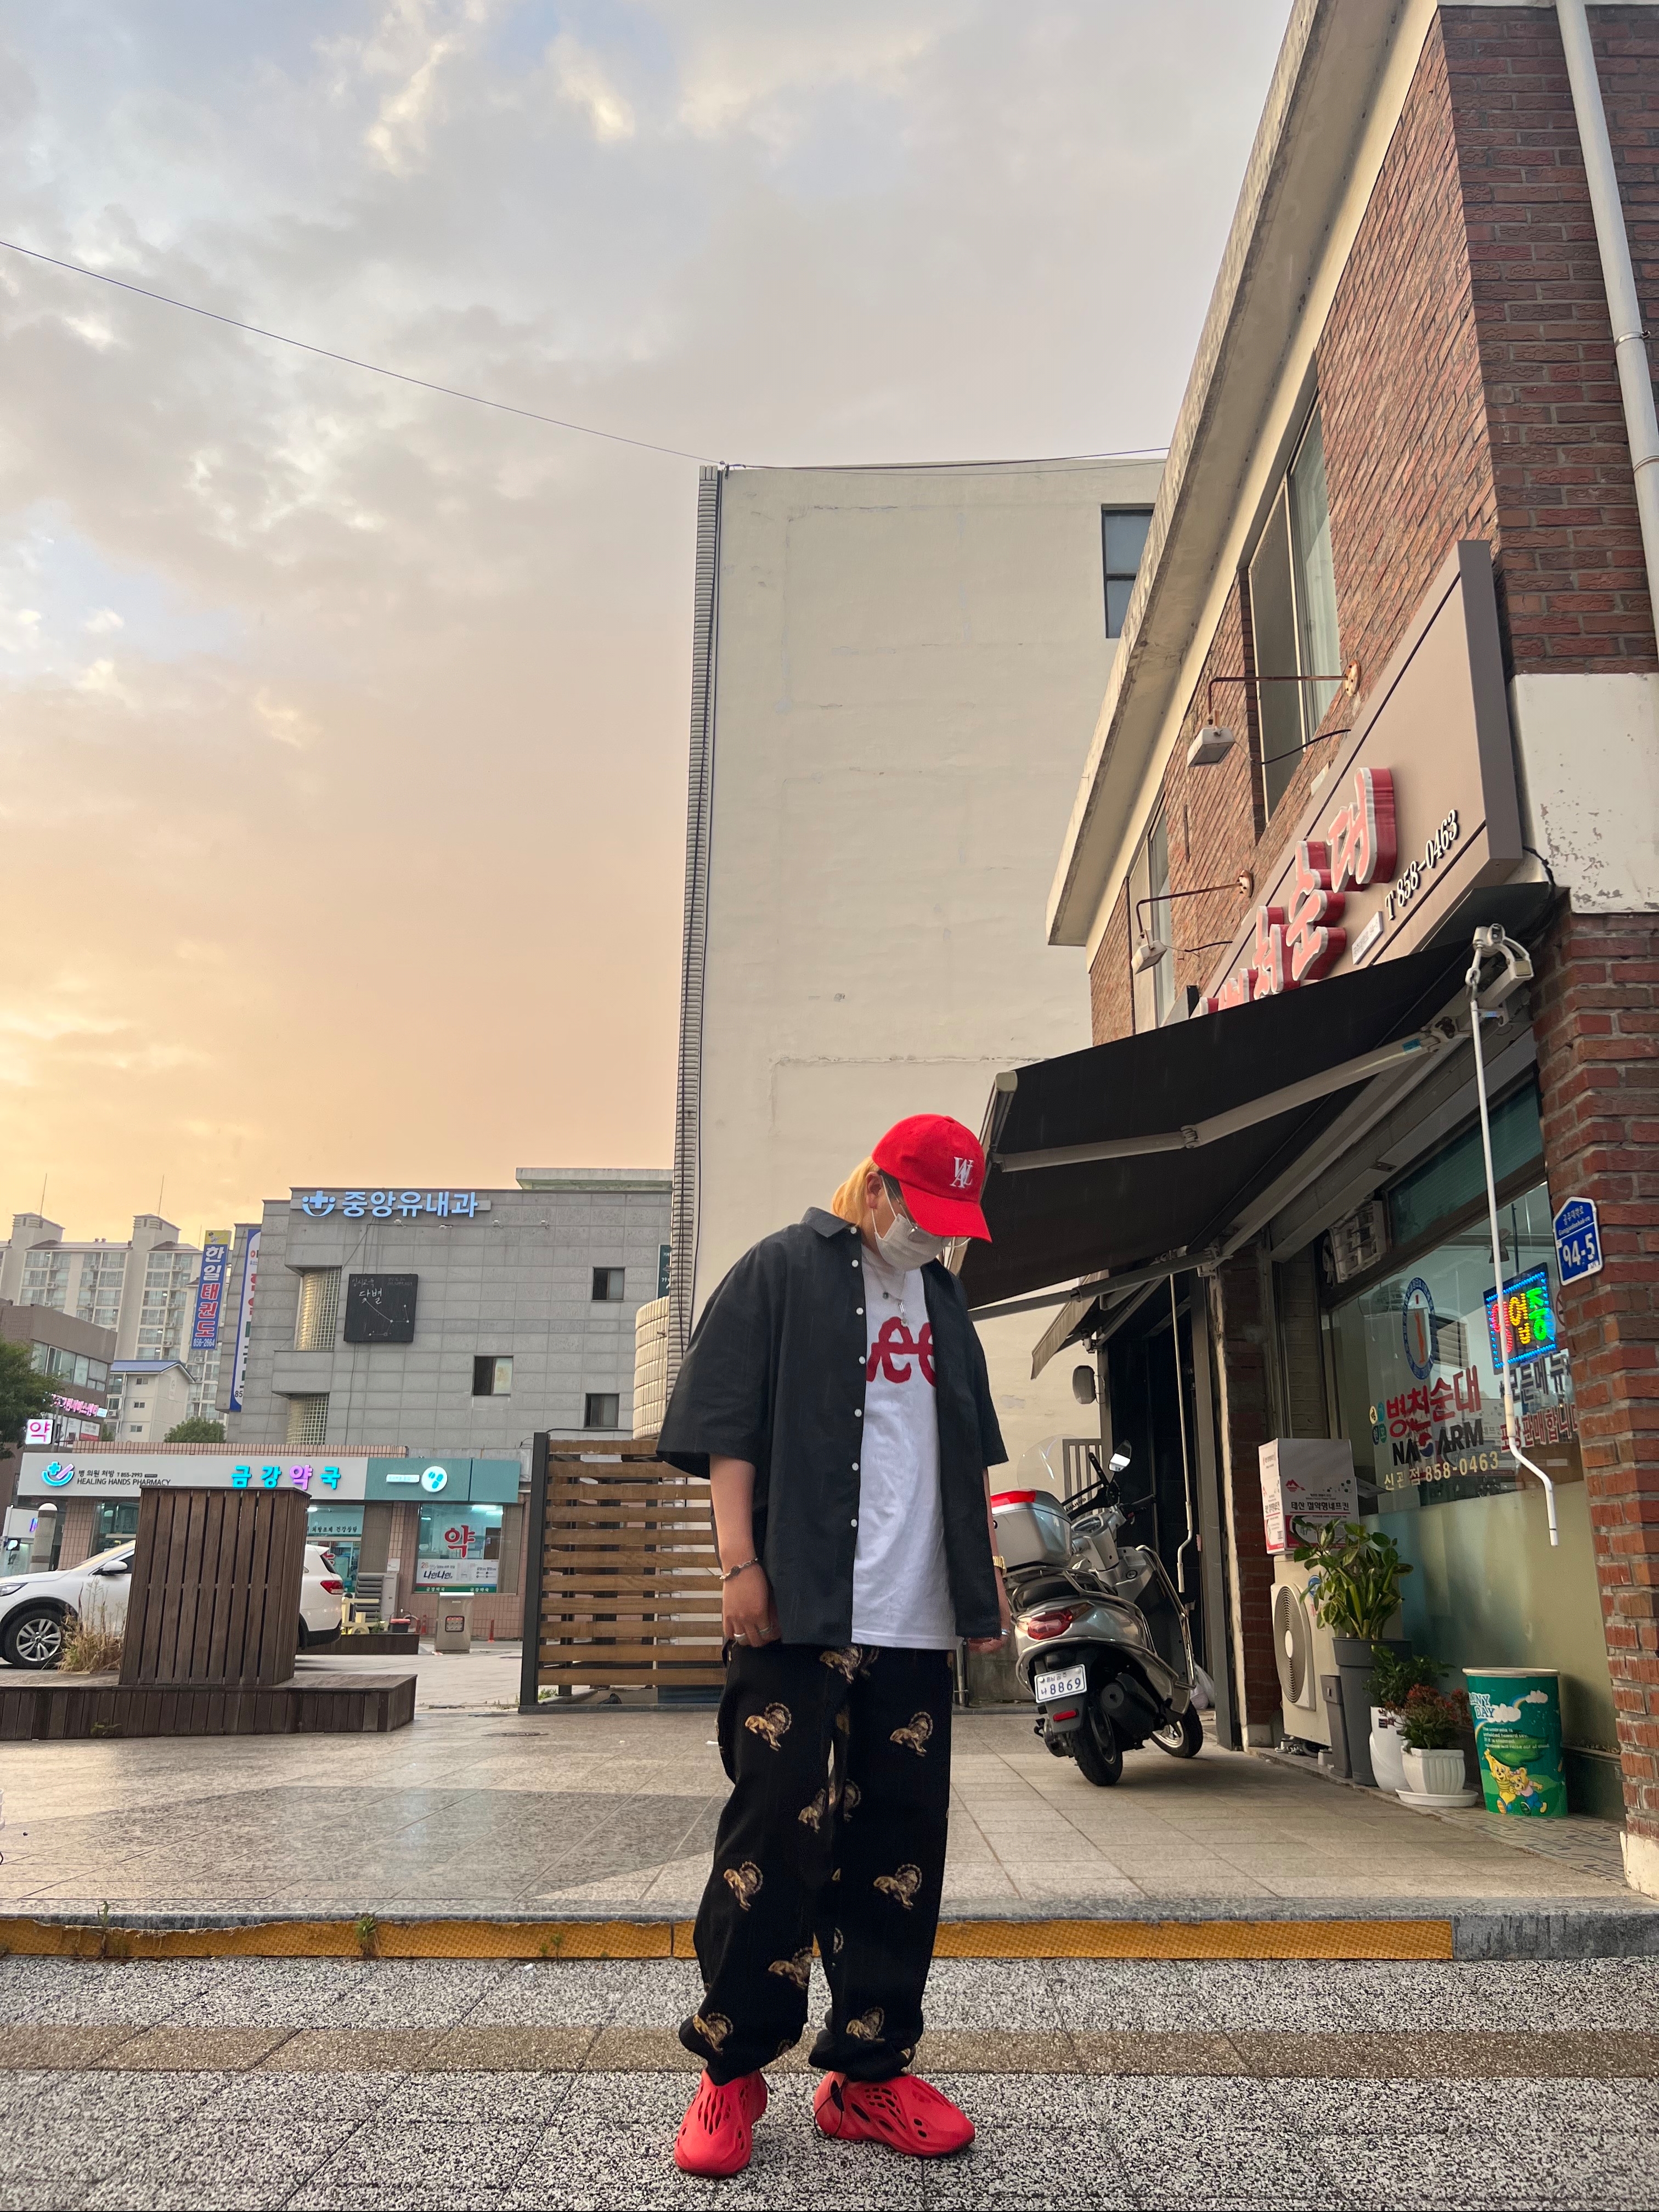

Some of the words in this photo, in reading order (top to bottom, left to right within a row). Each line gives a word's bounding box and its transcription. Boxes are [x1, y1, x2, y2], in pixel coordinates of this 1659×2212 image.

[1385, 888, 1395, 921] T
[1397, 809, 1459, 908] 858-0463
[342, 1190, 478, 1218] 중앙유내과
[1562, 1233, 1595, 1268] 94-5
[1386, 1364, 1482, 1438] 병천순대
[30, 1420, 51, 1442] 약
[231, 1464, 341, 1491] 금강약국
[1425, 1451, 1499, 1482] 858-0463
[444, 1524, 476, 1559] 약
[1049, 1678, 1081, 1695] 8869
[1475, 1707, 1496, 1718] DAY
